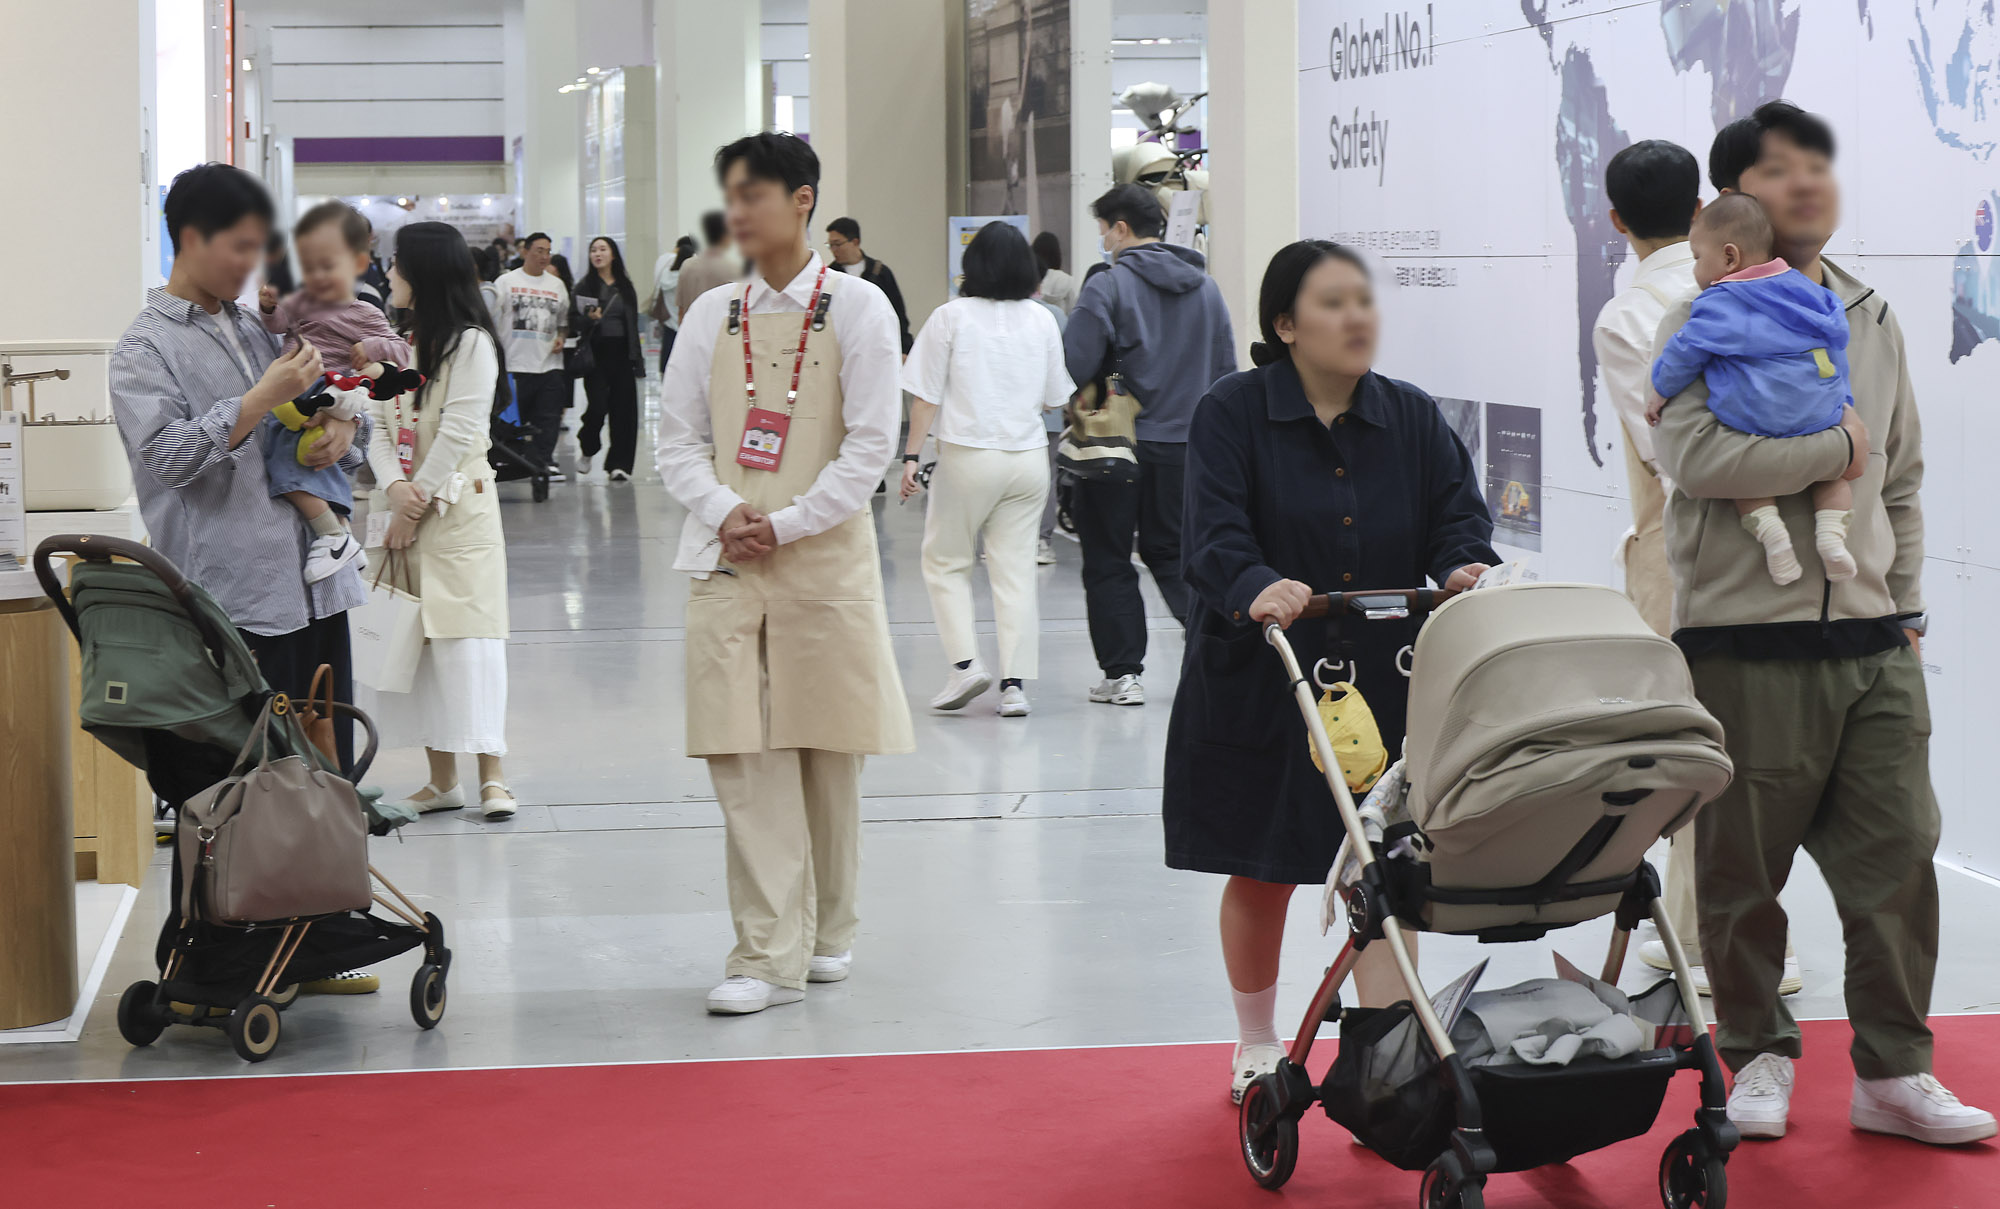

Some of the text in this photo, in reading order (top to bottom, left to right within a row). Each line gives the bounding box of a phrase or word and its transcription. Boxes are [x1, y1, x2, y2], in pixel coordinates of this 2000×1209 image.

[1330, 3, 1433, 82] Global No.1
[1330, 106, 1389, 187] Safety
